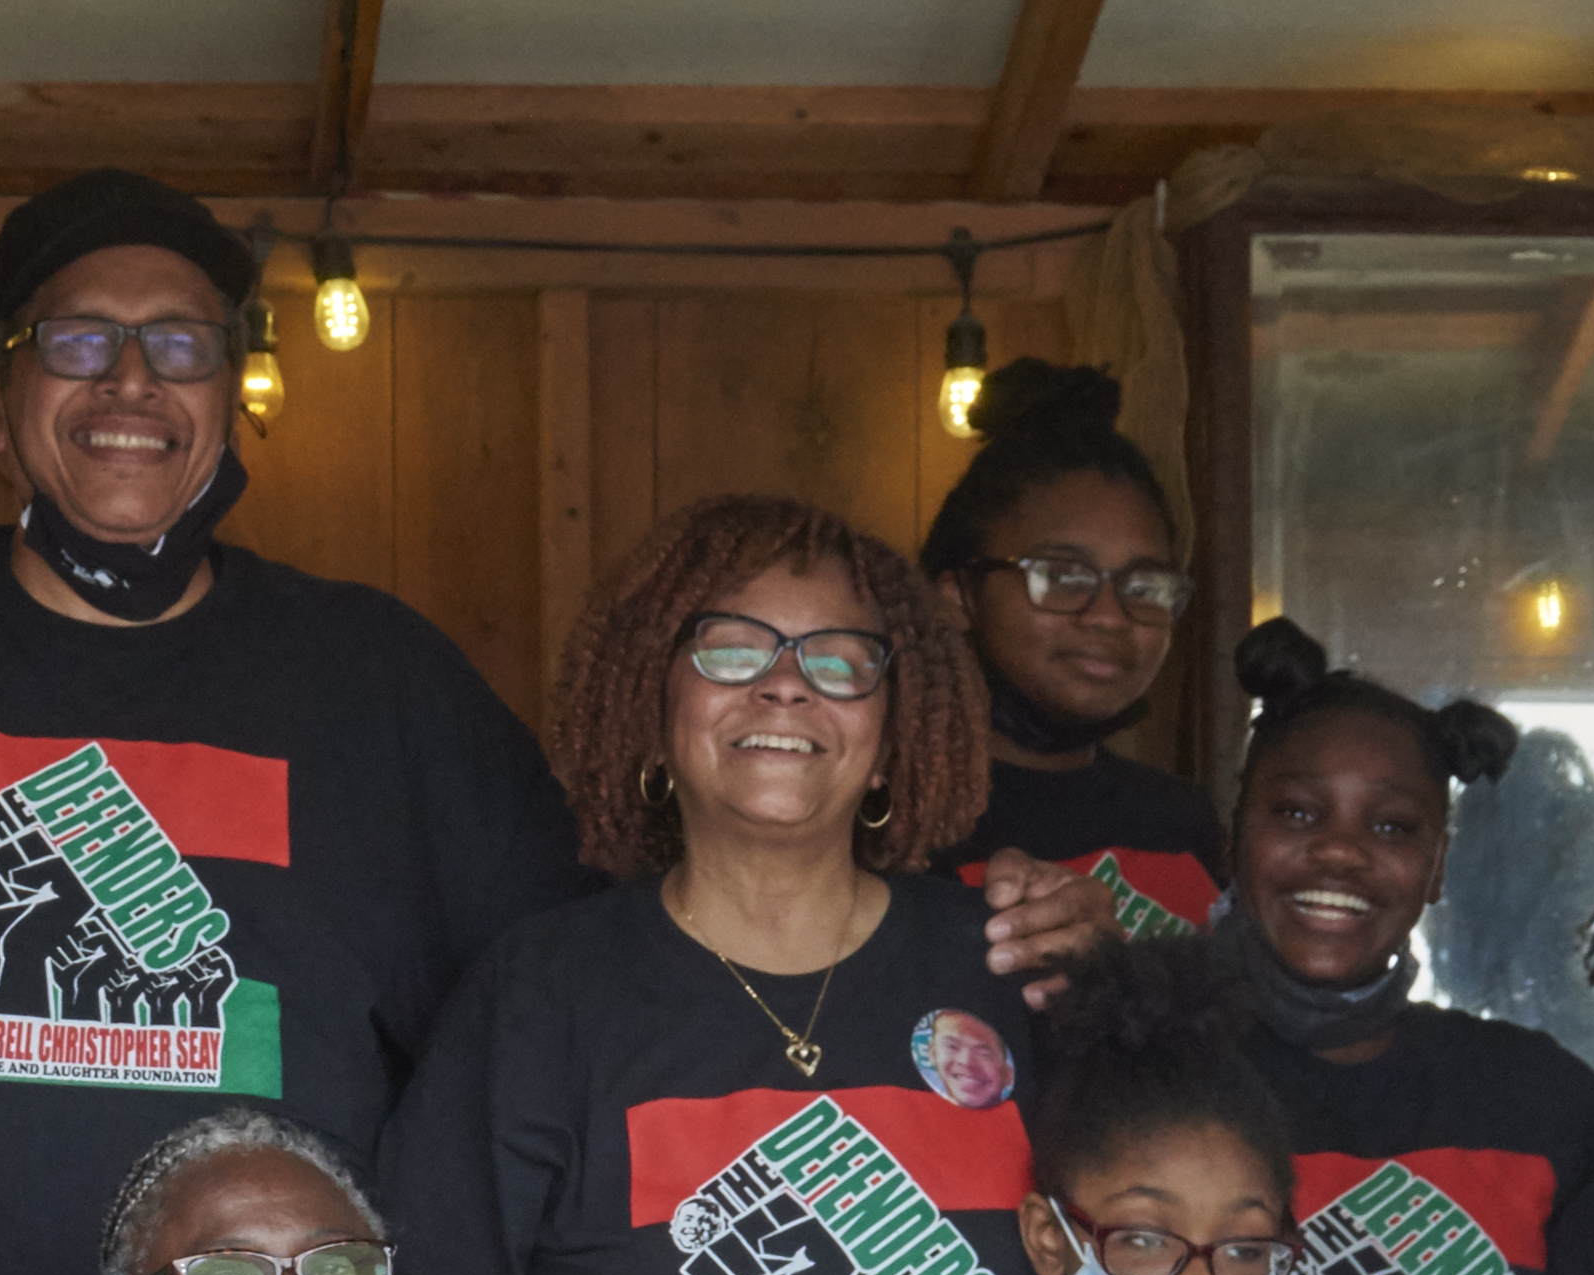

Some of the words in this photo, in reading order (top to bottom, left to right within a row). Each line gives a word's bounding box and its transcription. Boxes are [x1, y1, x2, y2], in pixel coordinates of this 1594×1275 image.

[17, 742, 230, 972] DEFENDERS
[8, 1062, 39, 1076] AND
[43, 1064, 120, 1081] LAUGHTER
[123, 1069, 217, 1085] FOUNDATION
[38, 1023, 171, 1069] CHRISTOPHER
[176, 1030, 221, 1071] SEAY
[700, 1149, 787, 1220] THE
